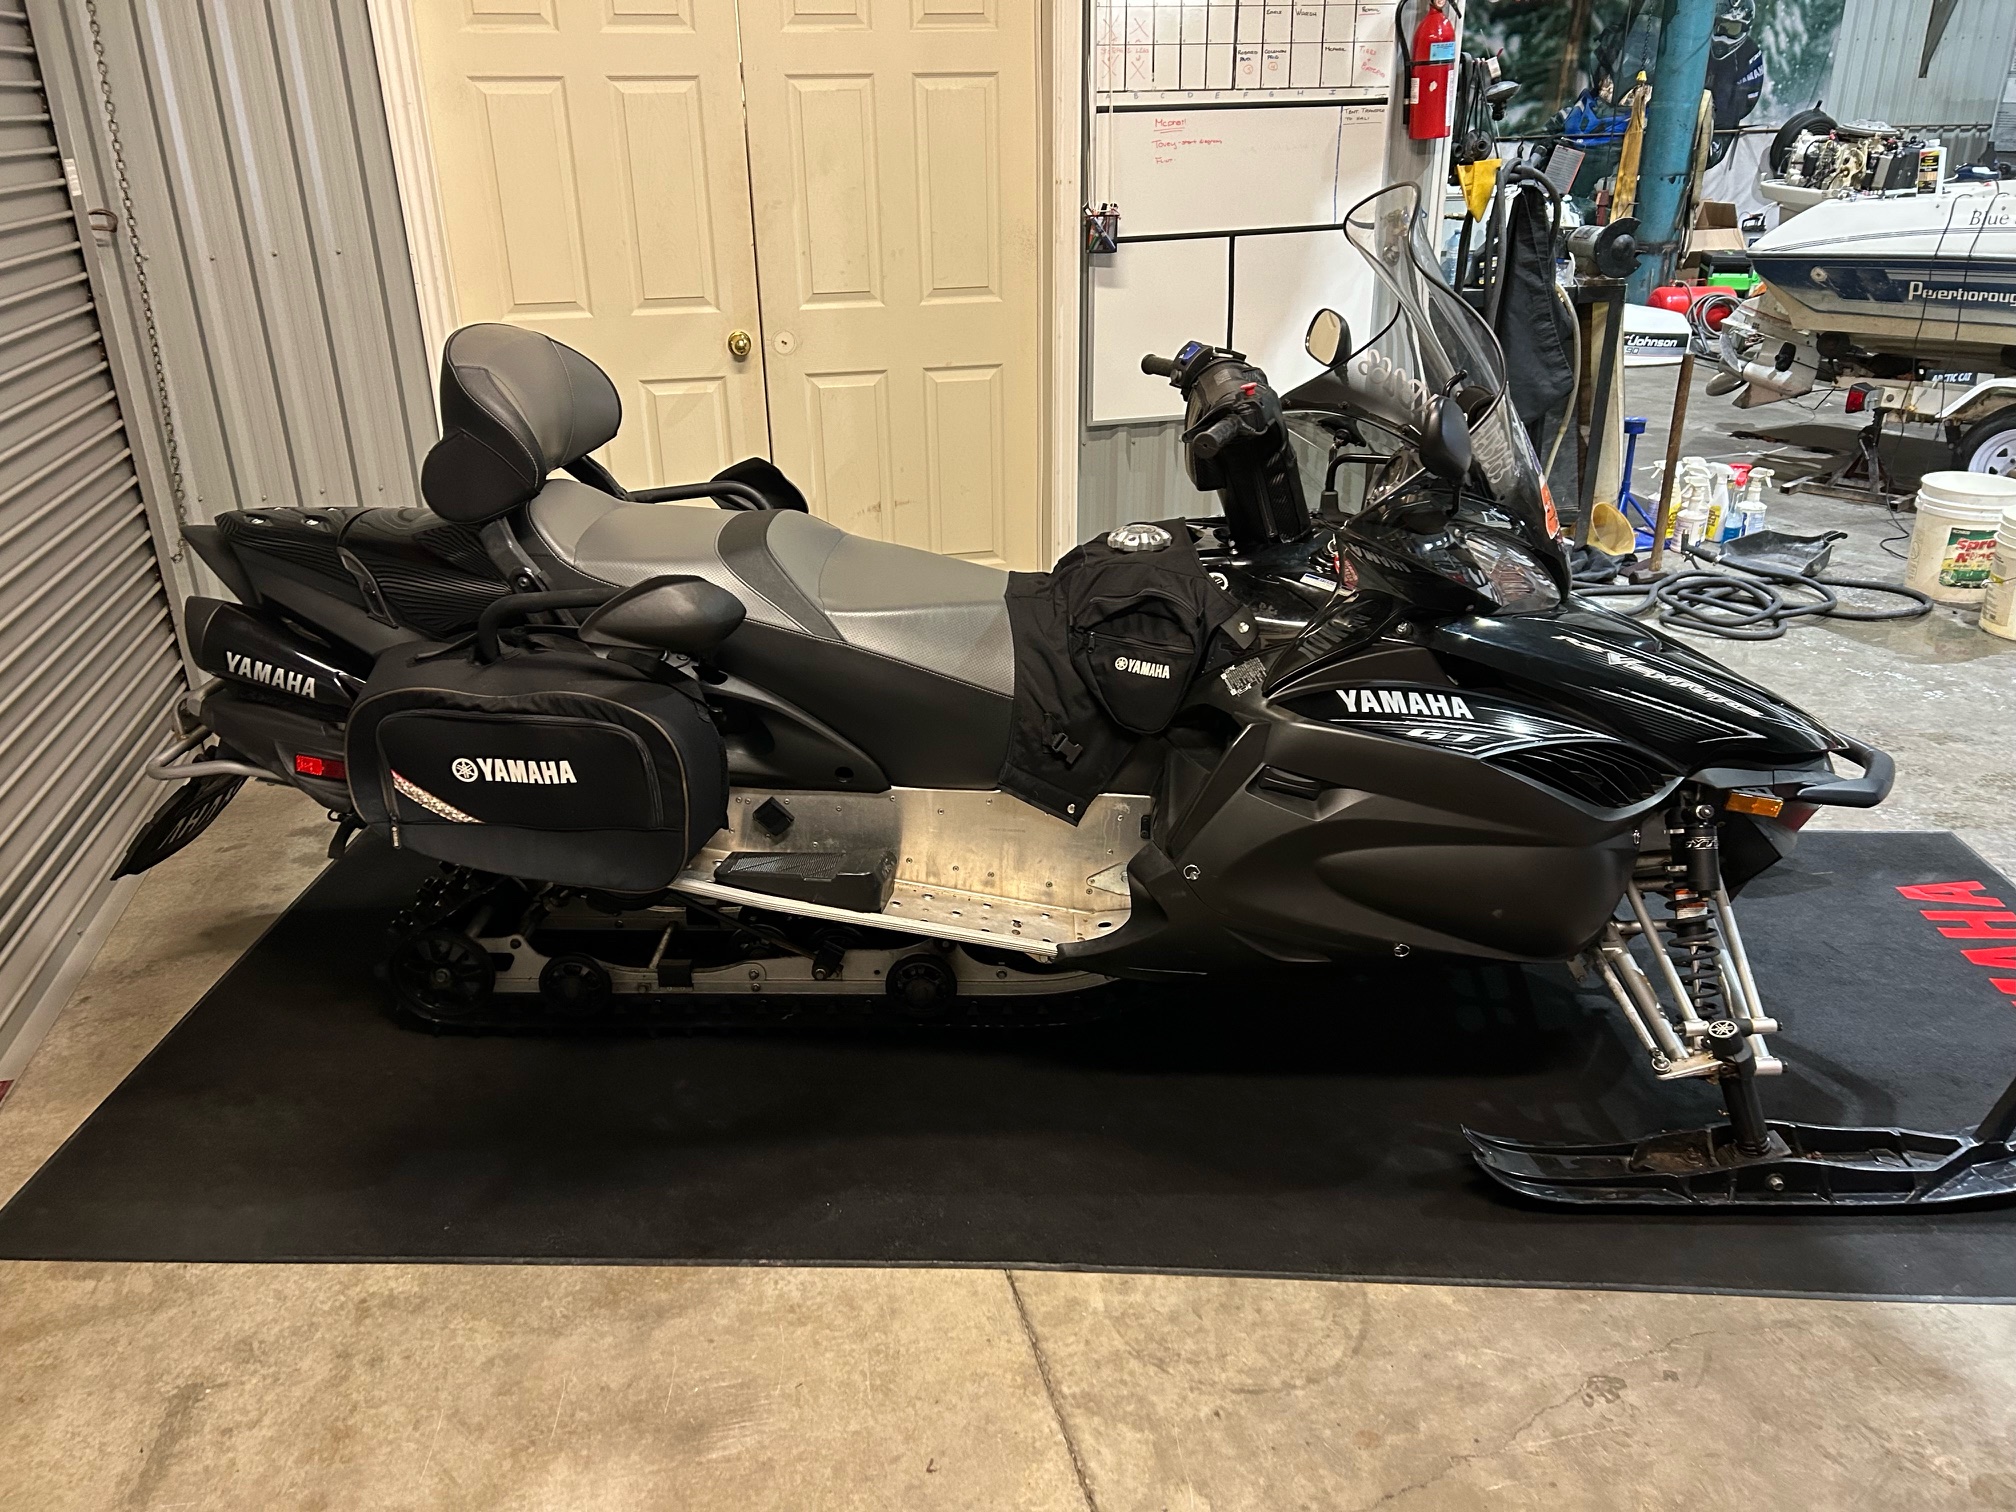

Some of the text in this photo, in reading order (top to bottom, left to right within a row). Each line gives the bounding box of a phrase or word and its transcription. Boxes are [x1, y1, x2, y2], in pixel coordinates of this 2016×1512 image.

[1627, 334, 1678, 347] Johnson
[1957, 372, 1973, 382] CAT
[226, 651, 316, 699] YAMAHA
[1127, 658, 1170, 680] YAMAHA
[1336, 689, 1475, 720] YAMAHA
[1405, 728, 1492, 743] GT
[477, 758, 577, 784] YAMAHA
